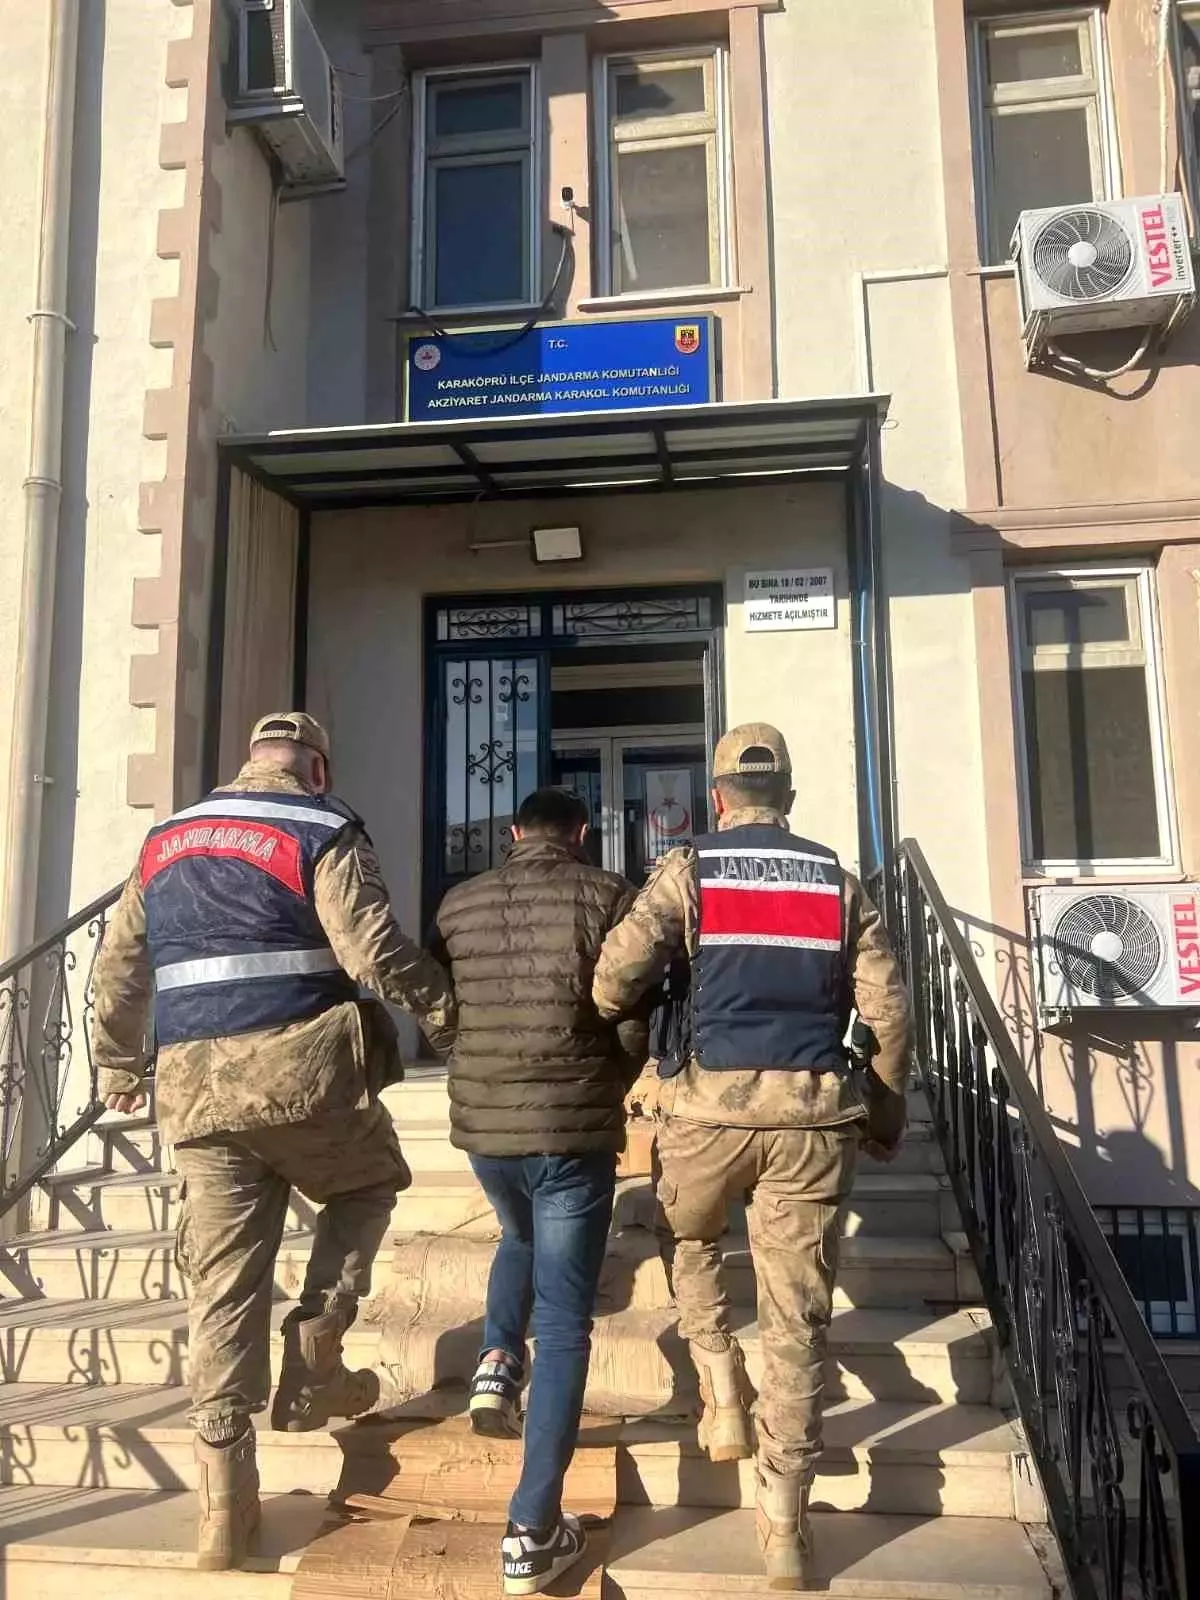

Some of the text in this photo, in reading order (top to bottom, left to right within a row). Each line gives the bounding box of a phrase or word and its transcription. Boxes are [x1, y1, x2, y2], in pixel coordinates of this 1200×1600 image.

[1142, 204, 1172, 287] VESTEL
[548, 339, 569, 349] T.C.
[437, 364, 680, 390] KARAKÖPRÜ İLÇE JANDARMA KOMUTANLIĞI
[427, 382, 690, 409] AKZİYARET JANDARMA KARAKOL KOMUTANLIĞI
[156, 827, 278, 863] JANDARMA
[713, 856, 828, 884] JANDARMA
[1173, 896, 1200, 995] VESTEL
[475, 1380, 505, 1393] NIKE
[504, 1561, 534, 1575] NIKE
